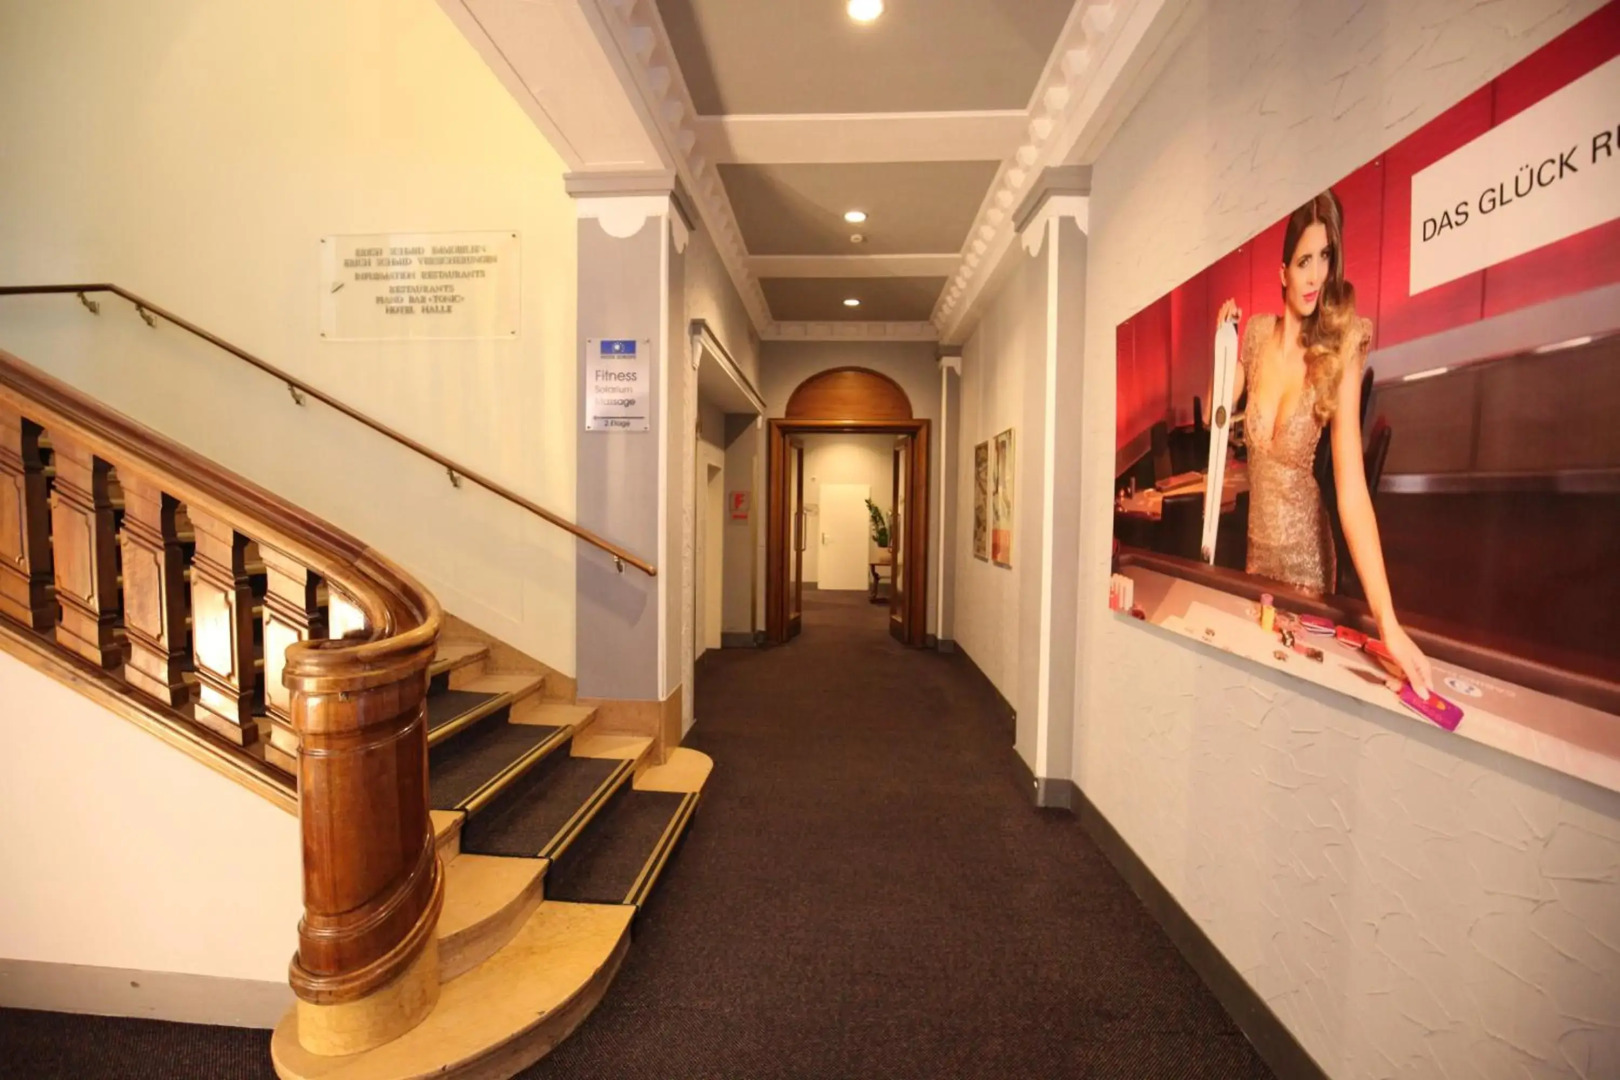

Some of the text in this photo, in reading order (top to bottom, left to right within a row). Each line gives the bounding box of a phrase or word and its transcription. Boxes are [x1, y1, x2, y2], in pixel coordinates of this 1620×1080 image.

[1422, 124, 1620, 242] DAS GLÜCK R
[421, 270, 486, 279] RESTAURANTS
[389, 285, 455, 293] RESTAURANTS
[408, 295, 426, 304] BAR
[385, 305, 452, 314] HOTEL HALLE
[595, 370, 637, 381] Fitness
[595, 385, 633, 394] Solarium
